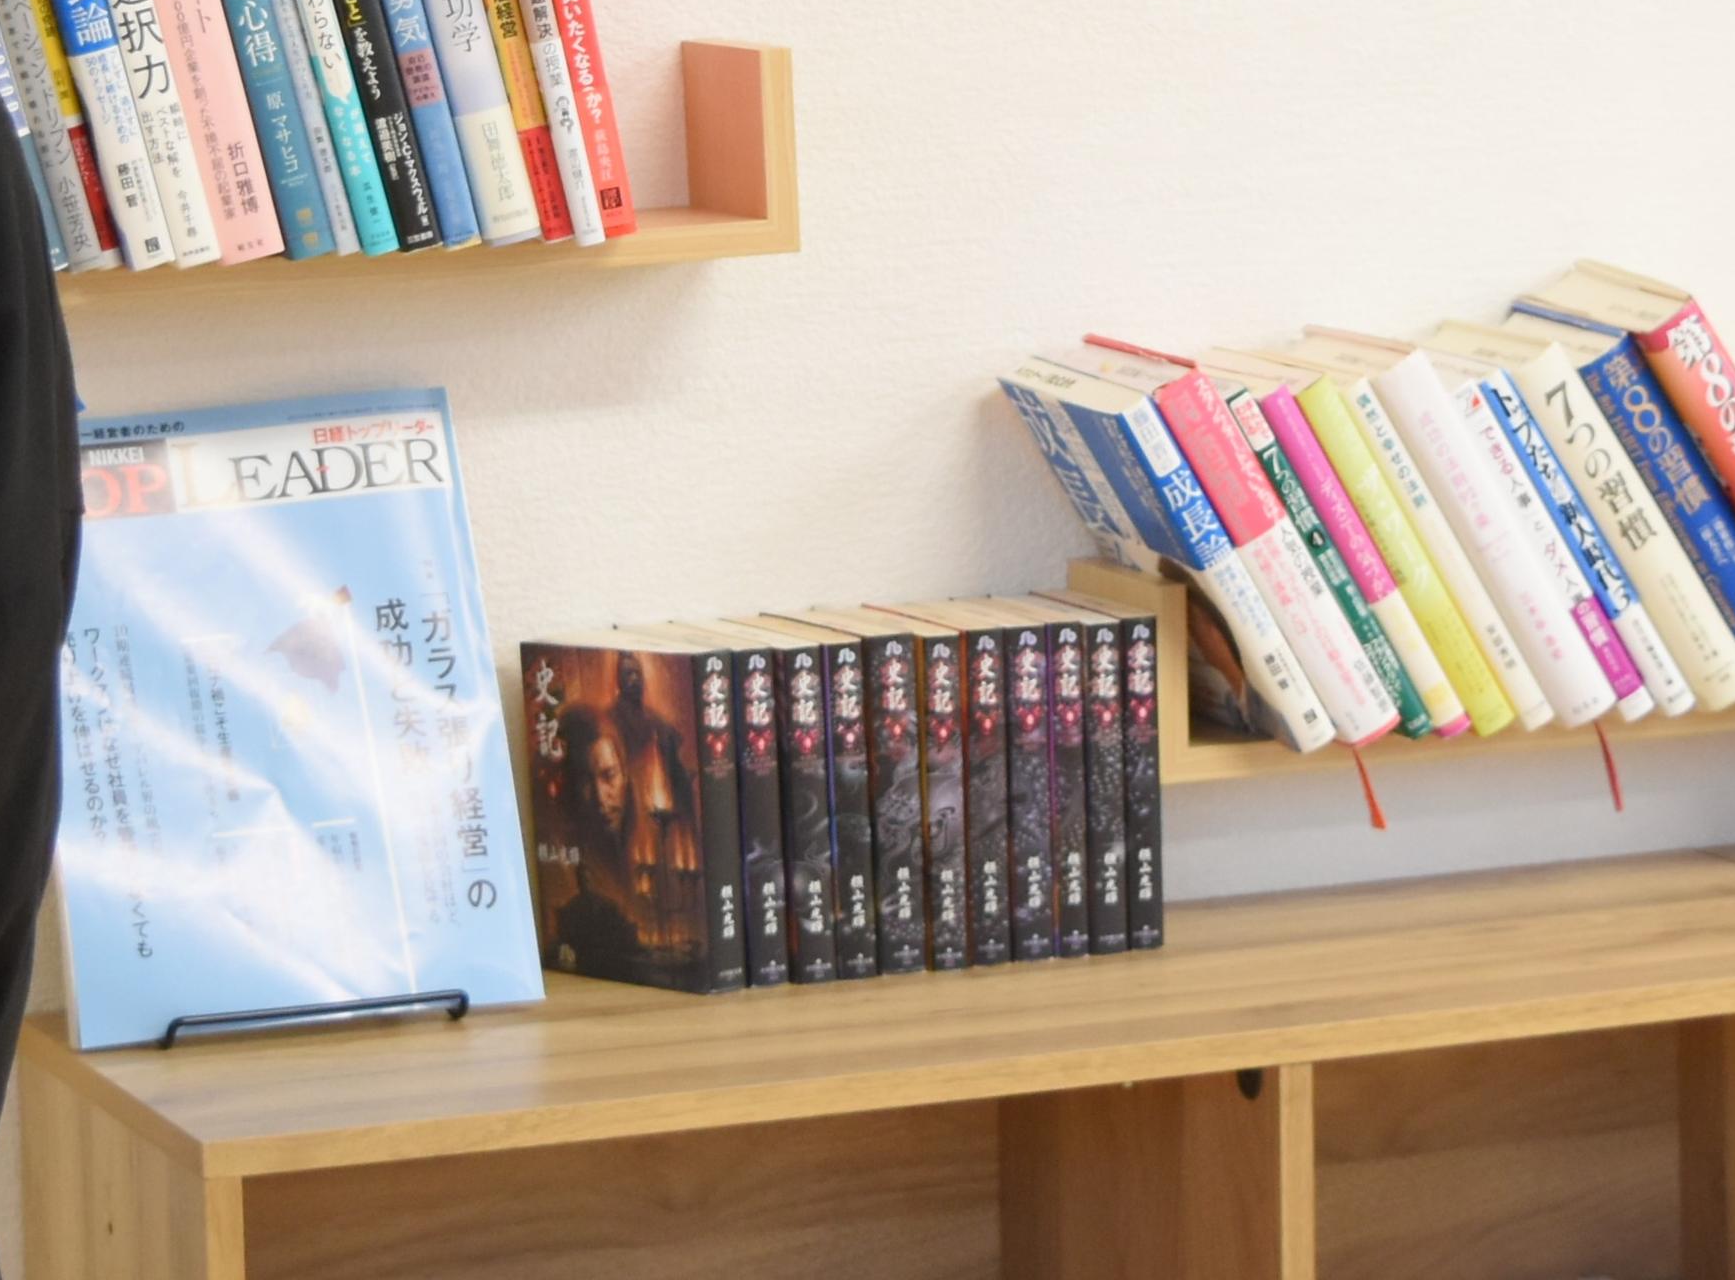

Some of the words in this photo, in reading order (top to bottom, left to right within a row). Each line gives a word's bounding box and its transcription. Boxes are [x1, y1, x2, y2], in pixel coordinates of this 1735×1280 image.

[541, 40, 565, 87] の授業
[266, 92, 285, 112] 原
[268, 114, 301, 175] マサヒコ
[227, 142, 259, 216] 折口雅博
[1602, 352, 1714, 517] 第8の習慣
[89, 448, 144, 465] NIKKEI
[171, 437, 444, 507] LEADER
[1545, 379, 1659, 554] 7つの習慣
[1161, 472, 1235, 571] 成長論
[1309, 531, 1324, 547] 4
[791, 667, 821, 726] 史記
[833, 665, 862, 722] 史記
[881, 657, 911, 714] 史記
[928, 657, 956, 714] 史記
[974, 654, 1001, 709] 史記
[1016, 651, 1044, 702] 史記
[1056, 647, 1084, 701] 史記
[1094, 648, 1119, 702] 史記
[1128, 641, 1155, 697] 史記
[533, 660, 563, 760] 史記
[702, 671, 730, 729] 史記
[744, 668, 773, 728] 史記
